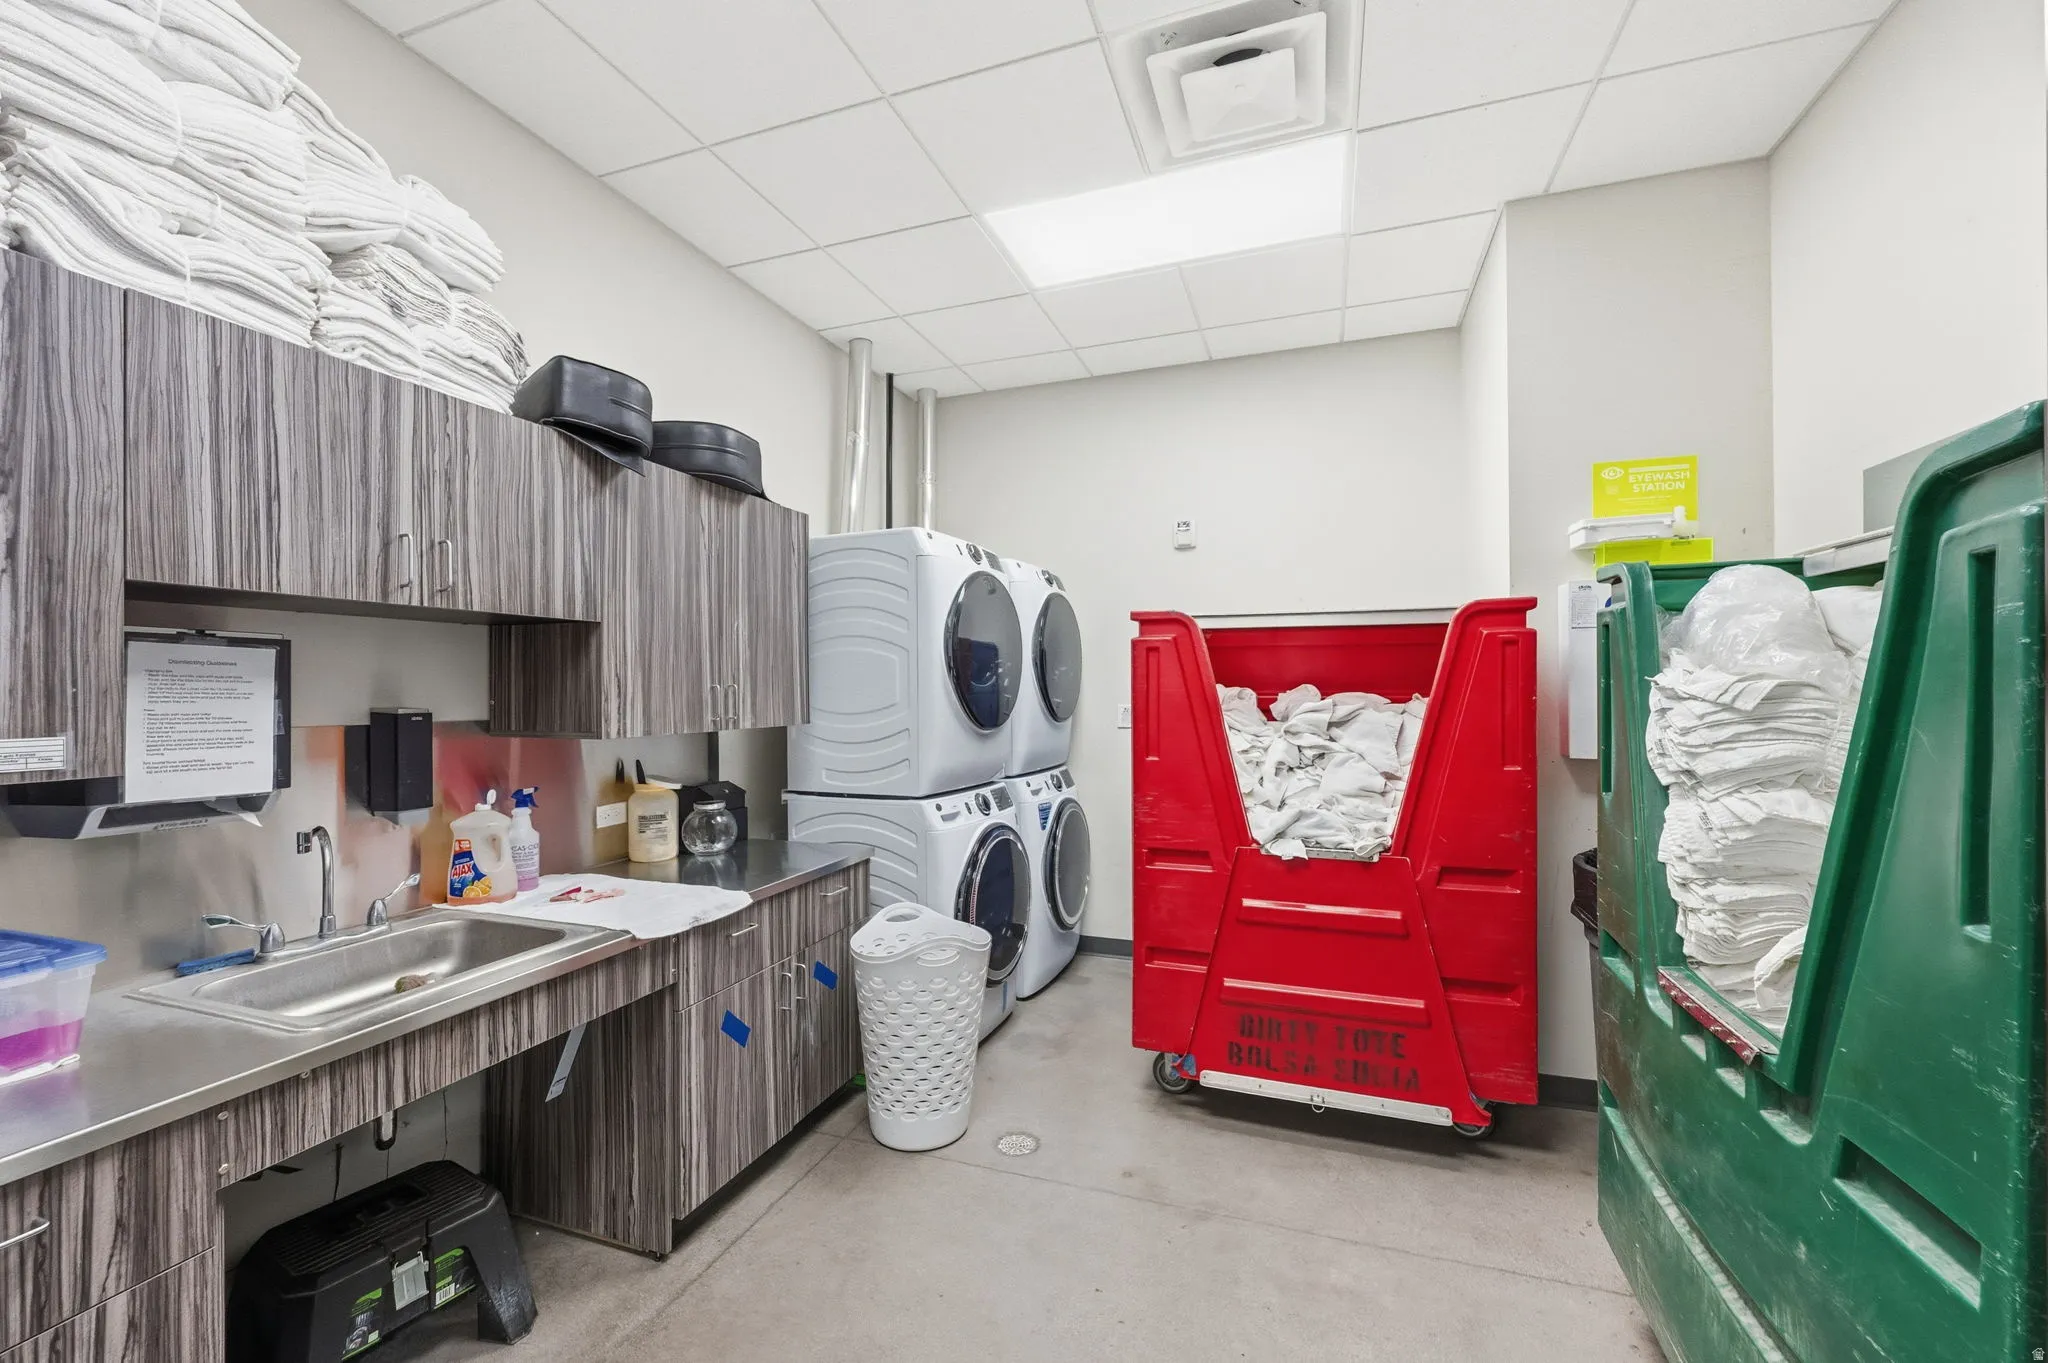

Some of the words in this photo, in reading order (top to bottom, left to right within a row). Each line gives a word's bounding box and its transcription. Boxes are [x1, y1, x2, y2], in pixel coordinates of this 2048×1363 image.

[1628, 470, 1690, 483] EYEWASH
[1633, 481, 1685, 493] STATION
[452, 862, 472, 878] AJAX
[1240, 1014, 1318, 1045] DIRTY
[1334, 1026, 1407, 1059] TOTE
[1228, 1041, 1318, 1076] BOLSA
